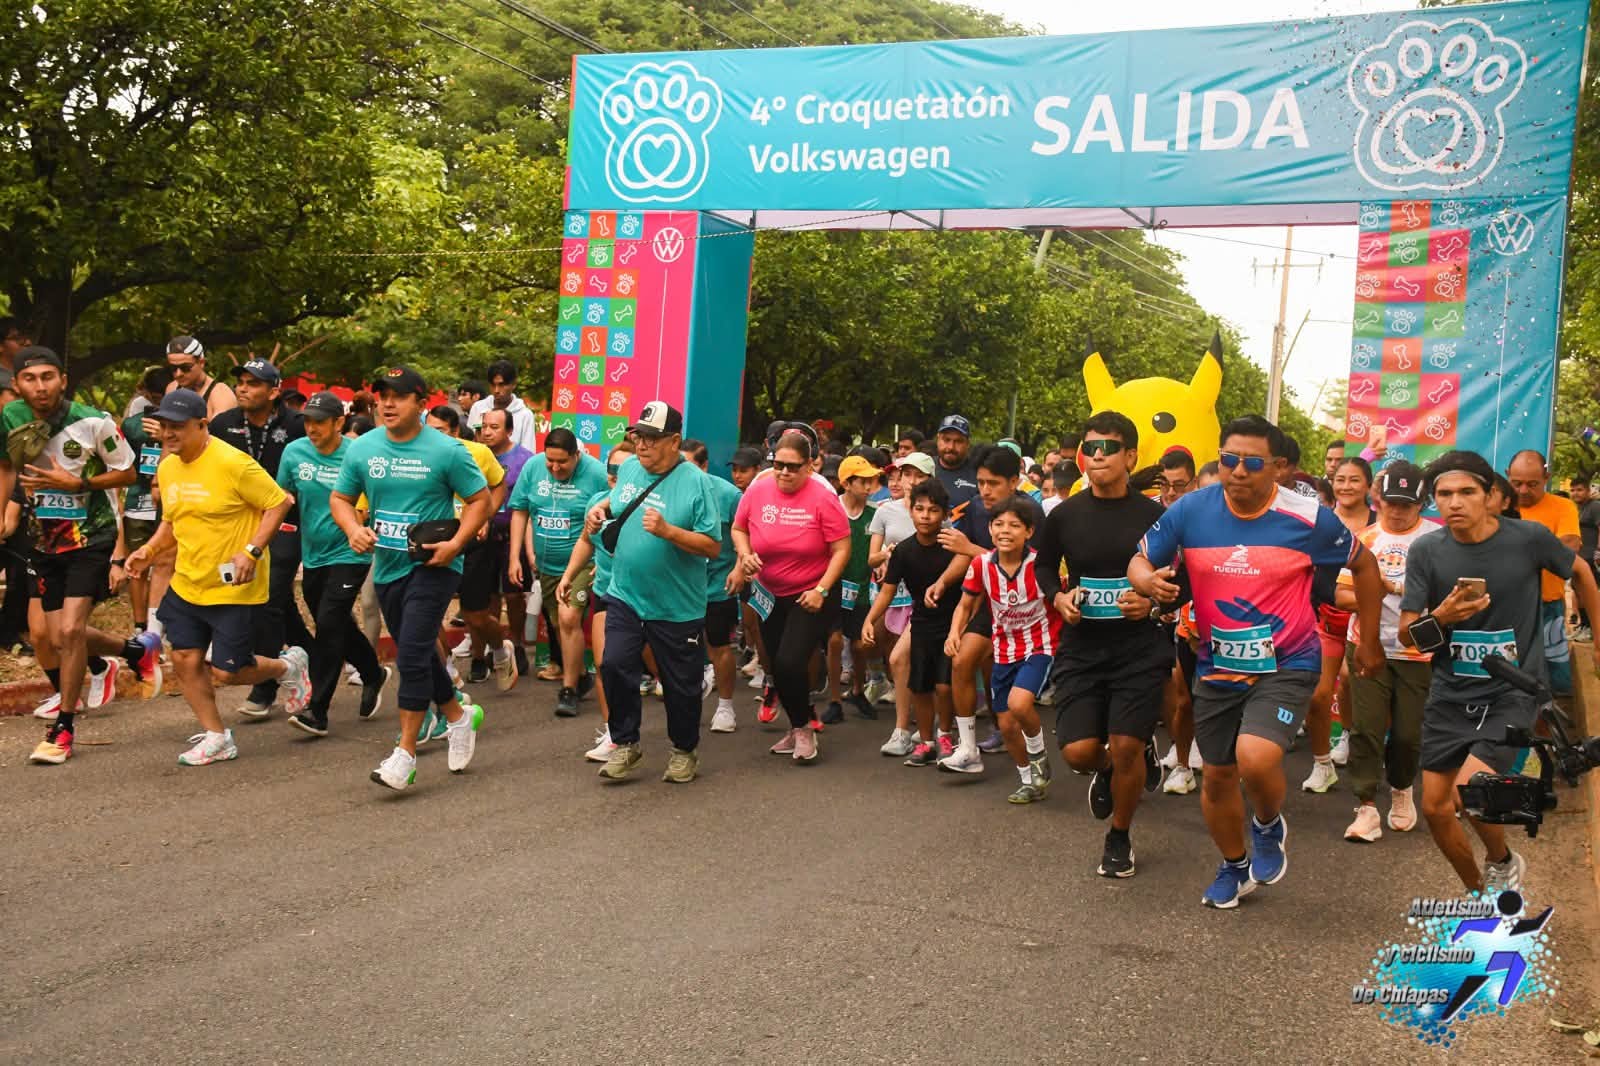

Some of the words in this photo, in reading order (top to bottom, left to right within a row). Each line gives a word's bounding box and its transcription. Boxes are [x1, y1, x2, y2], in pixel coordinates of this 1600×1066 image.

[796, 86, 1010, 129] Croquetatón
[1031, 88, 1310, 155] SALIDA
[749, 142, 951, 177] Volkswagen
[47, 494, 74, 508] 263
[382, 522, 408, 538] 376
[543, 518, 563, 529] 330
[1223, 641, 1261, 658] 275
[1465, 644, 1503, 661] 086
